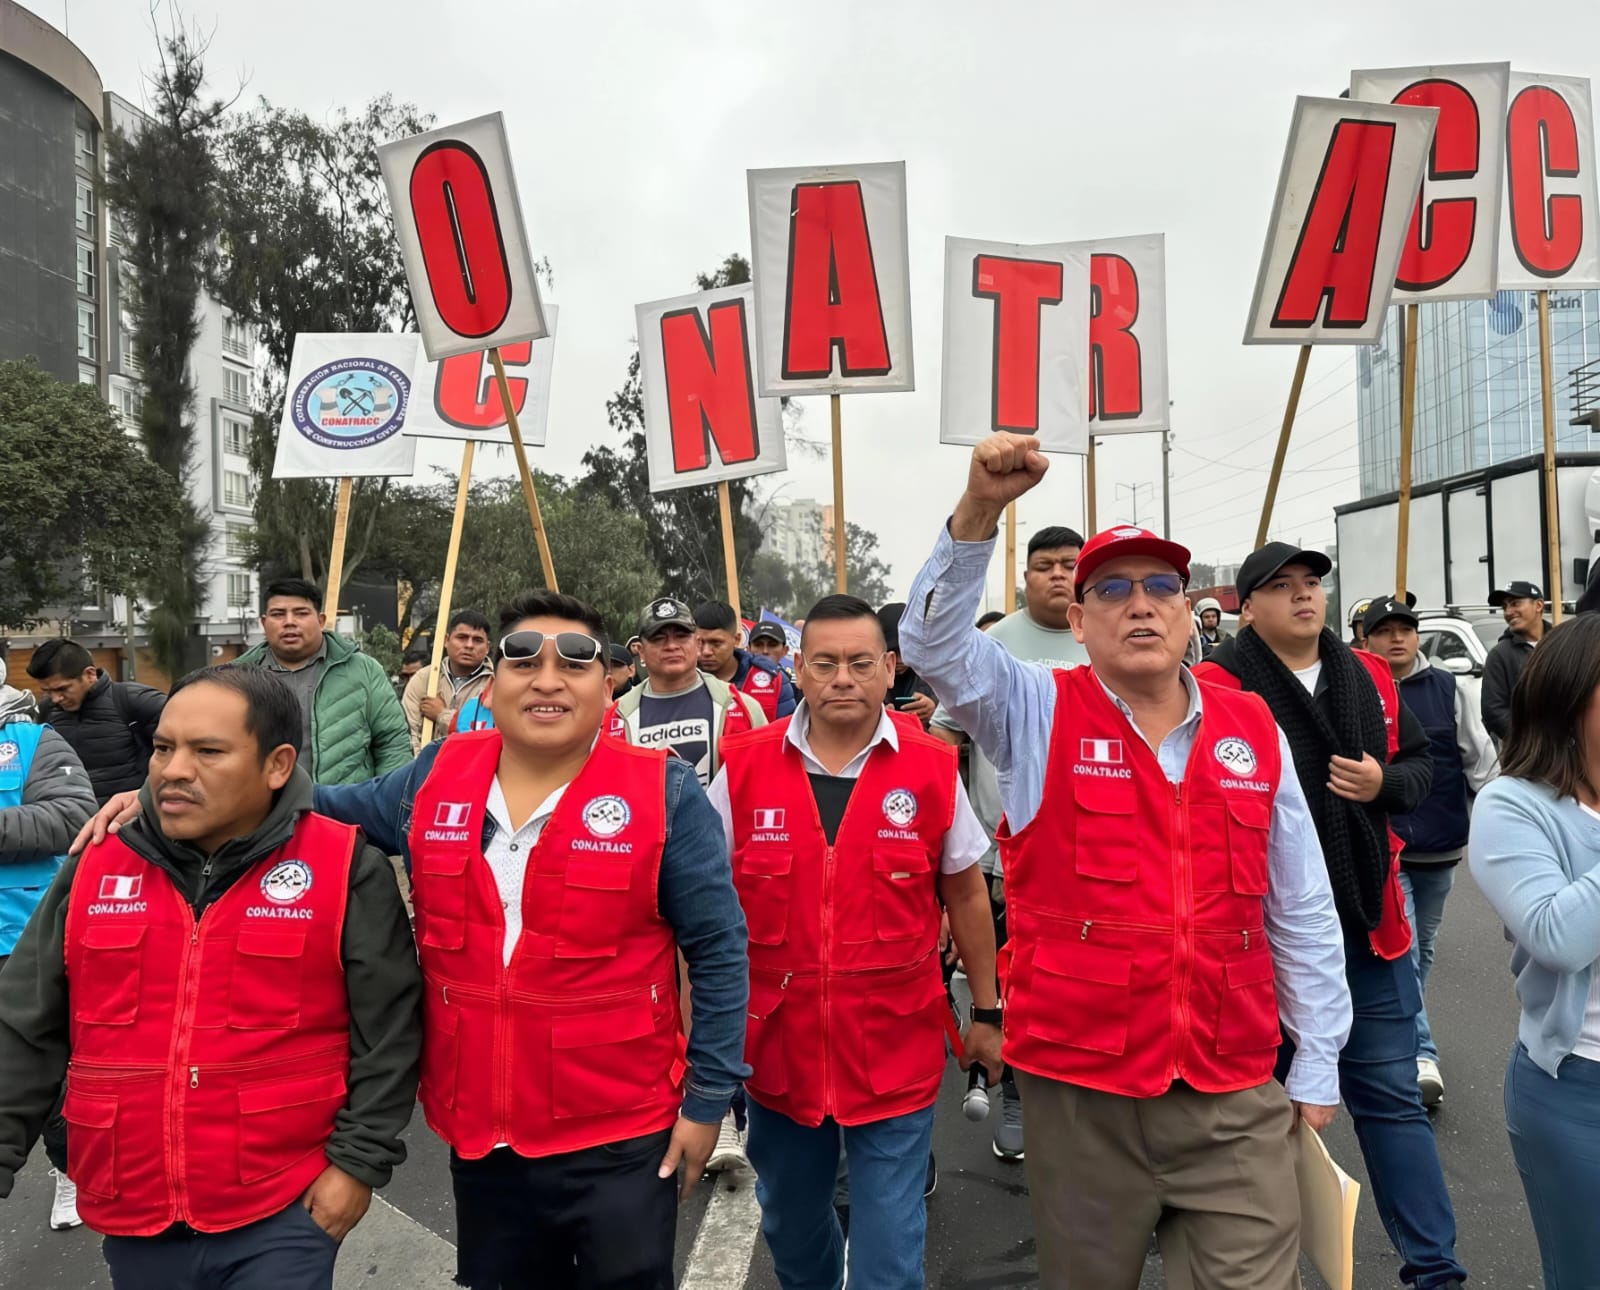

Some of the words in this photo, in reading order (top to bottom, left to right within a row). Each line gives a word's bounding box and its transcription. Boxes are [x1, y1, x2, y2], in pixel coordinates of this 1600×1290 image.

[409, 138, 514, 338] O
[1270, 118, 1396, 329] A
[1390, 78, 1480, 292] C
[1506, 85, 1584, 279] C
[781, 180, 892, 380] A
[972, 253, 1063, 435] T
[1089, 253, 1142, 420] R
[321, 416, 380, 427] CONATRACC
[376, 423, 398, 440] CIVIL
[434, 340, 533, 431] C
[660, 297, 760, 474] N
[639, 725, 702, 744] adidas
[1073, 764, 1132, 779] CONATRACC
[88, 901, 147, 916] CONATRACC
[571, 839, 633, 853] CONATRACC
[246, 906, 312, 920] CONATRACC
